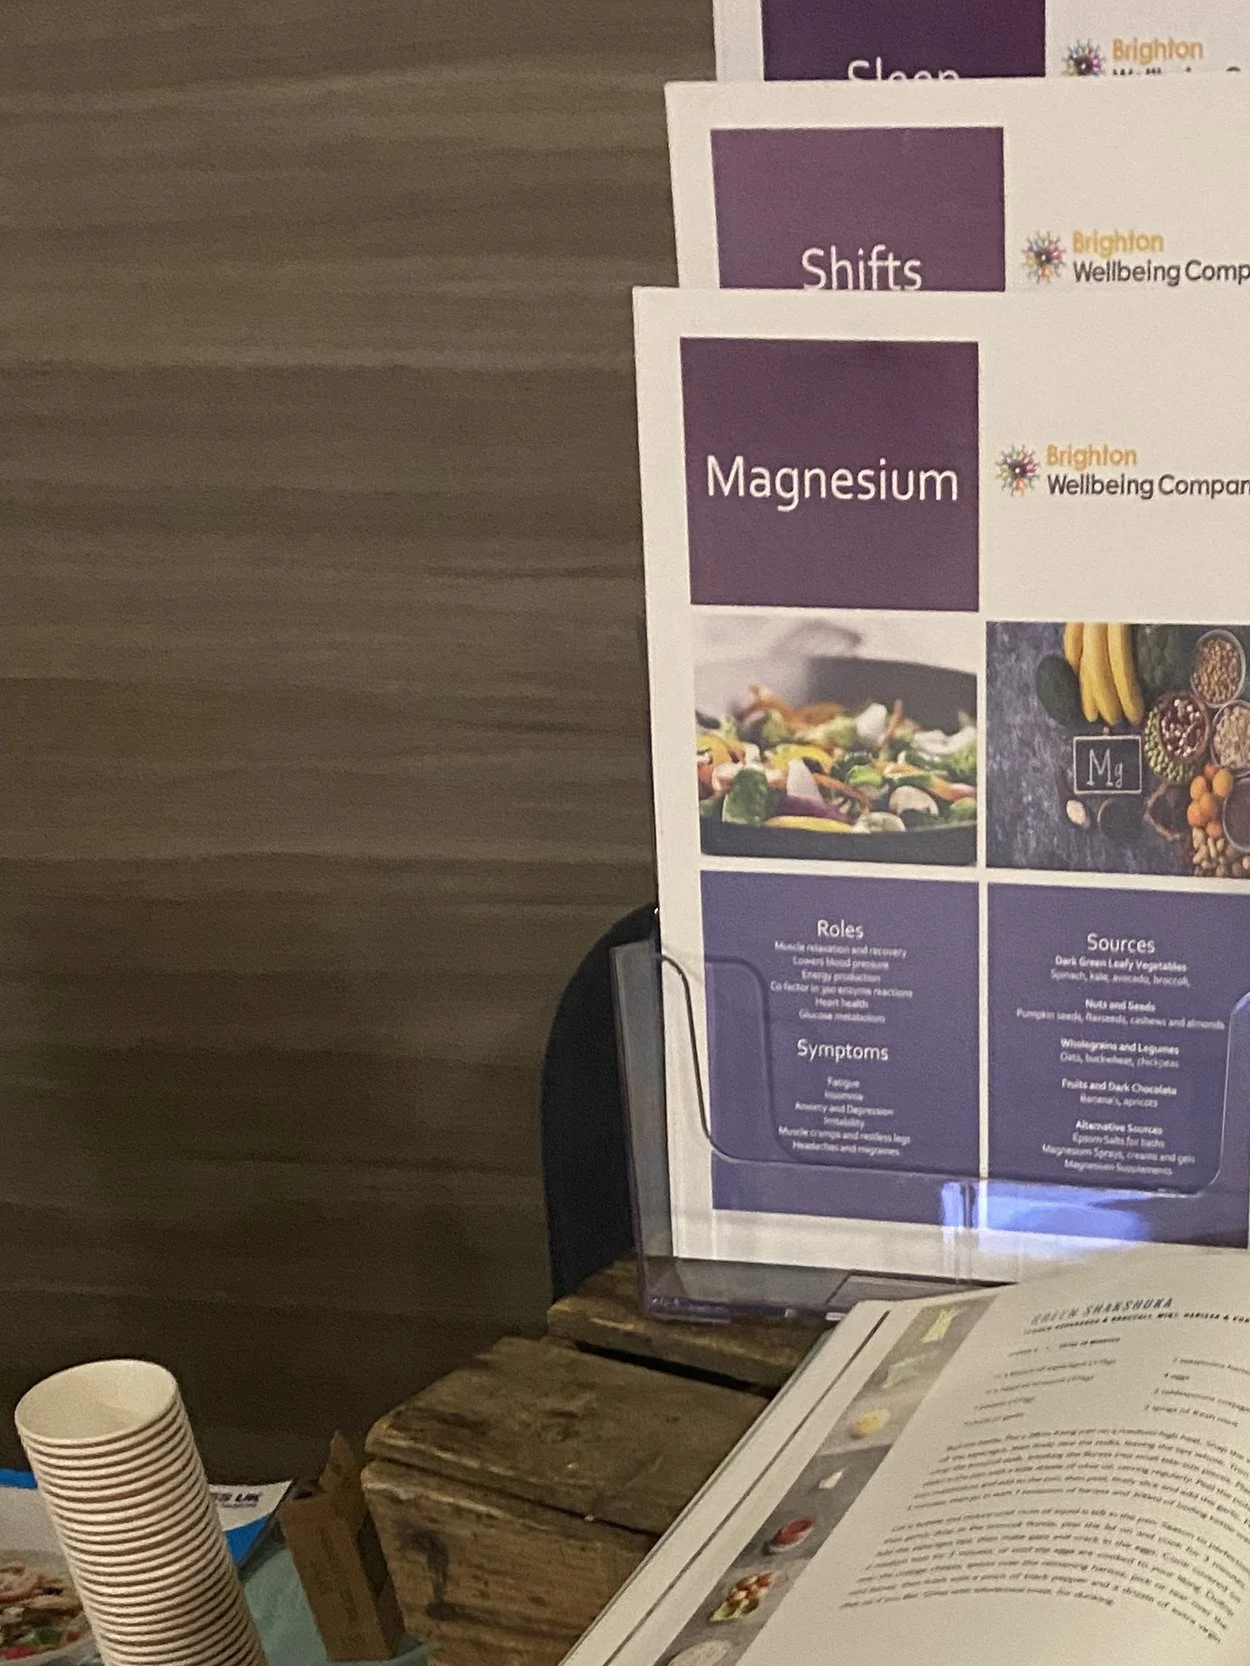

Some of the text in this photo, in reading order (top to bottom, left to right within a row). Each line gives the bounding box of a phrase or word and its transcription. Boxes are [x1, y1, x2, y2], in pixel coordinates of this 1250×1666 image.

[1112, 38, 1203, 64] Brighton
[1072, 229, 1164, 255] Brighton
[800, 244, 922, 291] Shifts
[1072, 259, 1181, 286] Wellbeing
[1046, 444, 1138, 469] Brighton
[706, 455, 959, 512] Magnesium
[1046, 473, 1154, 500] Wellbeing
[818, 919, 864, 938] Roles
[852, 945, 868, 954] and
[1087, 932, 1155, 953] Sources
[1056, 955, 1187, 972] Dark Green Leafy Vegetables
[1085, 999, 1156, 1012] Nuts and Seeds
[1168, 1018, 1185, 1028] and
[797, 1039, 888, 1063] Symptoms
[1119, 1043, 1136, 1052] and
[1089, 1081, 1106, 1090] and
[1109, 1082, 1129, 1092] Dark
